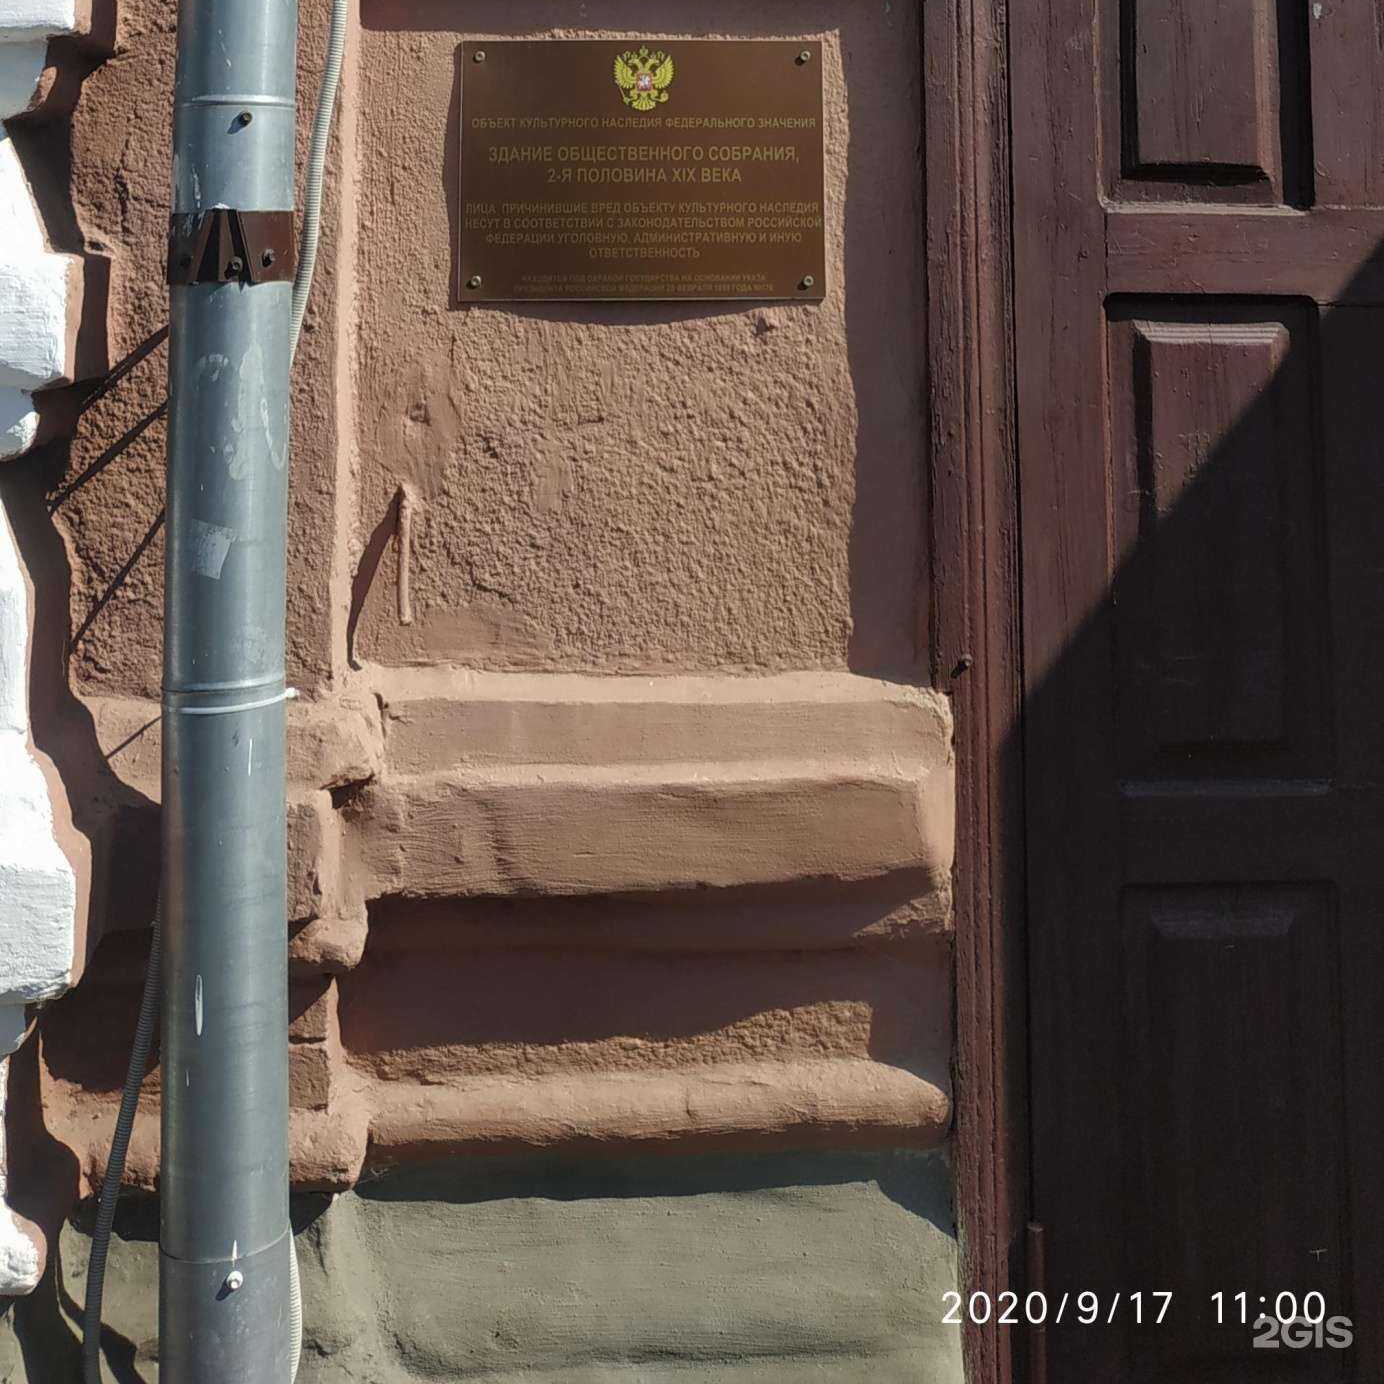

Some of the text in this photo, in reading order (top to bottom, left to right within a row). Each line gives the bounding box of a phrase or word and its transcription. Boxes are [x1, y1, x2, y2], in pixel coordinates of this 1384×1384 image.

[471, 117, 817, 129] ОБЪЕКТ КУЛЬТУРНОГО НАСЛЕДИЯ ФЕДЕРАЛЬНОГО ЗНАЧЕНИЯ
[488, 145, 800, 164] ЗДАНИЕ ОБЩЕСТВЕННОГО СОБРАНИЯ,
[547, 168, 572, 183] 2-Я
[577, 167, 667, 183] ПОЛОВИНА
[701, 167, 742, 183] ВЕКА
[501, 202, 588, 214] ПРИЧИНИВШИЕ
[591, 202, 621, 214] ВРЕД
[623, 202, 675, 213] ОБЪЕКТУ
[678, 202, 757, 213] КУЛЬТУРНОГО
[759, 202, 819, 213] НАСЛЕДИЯ
[465, 217, 501, 229] НЕСУТ
[503, 217, 512, 229] В
[513, 217, 604, 229] СООТВЕТСТВИИ
[606, 217, 615, 229] С
[618, 217, 745, 229] ЗАКОНОДАТЕЛЬСТВОМ
[486, 232, 555, 244] ФЕДЕРАЦИИ
[633, 232, 758, 244] АДМИНИСТРАТИВНУЮ
[769, 232, 802, 243] ИНУЮ
[588, 247, 701, 259] ОТВЕТСТВЕННОСТЬ
